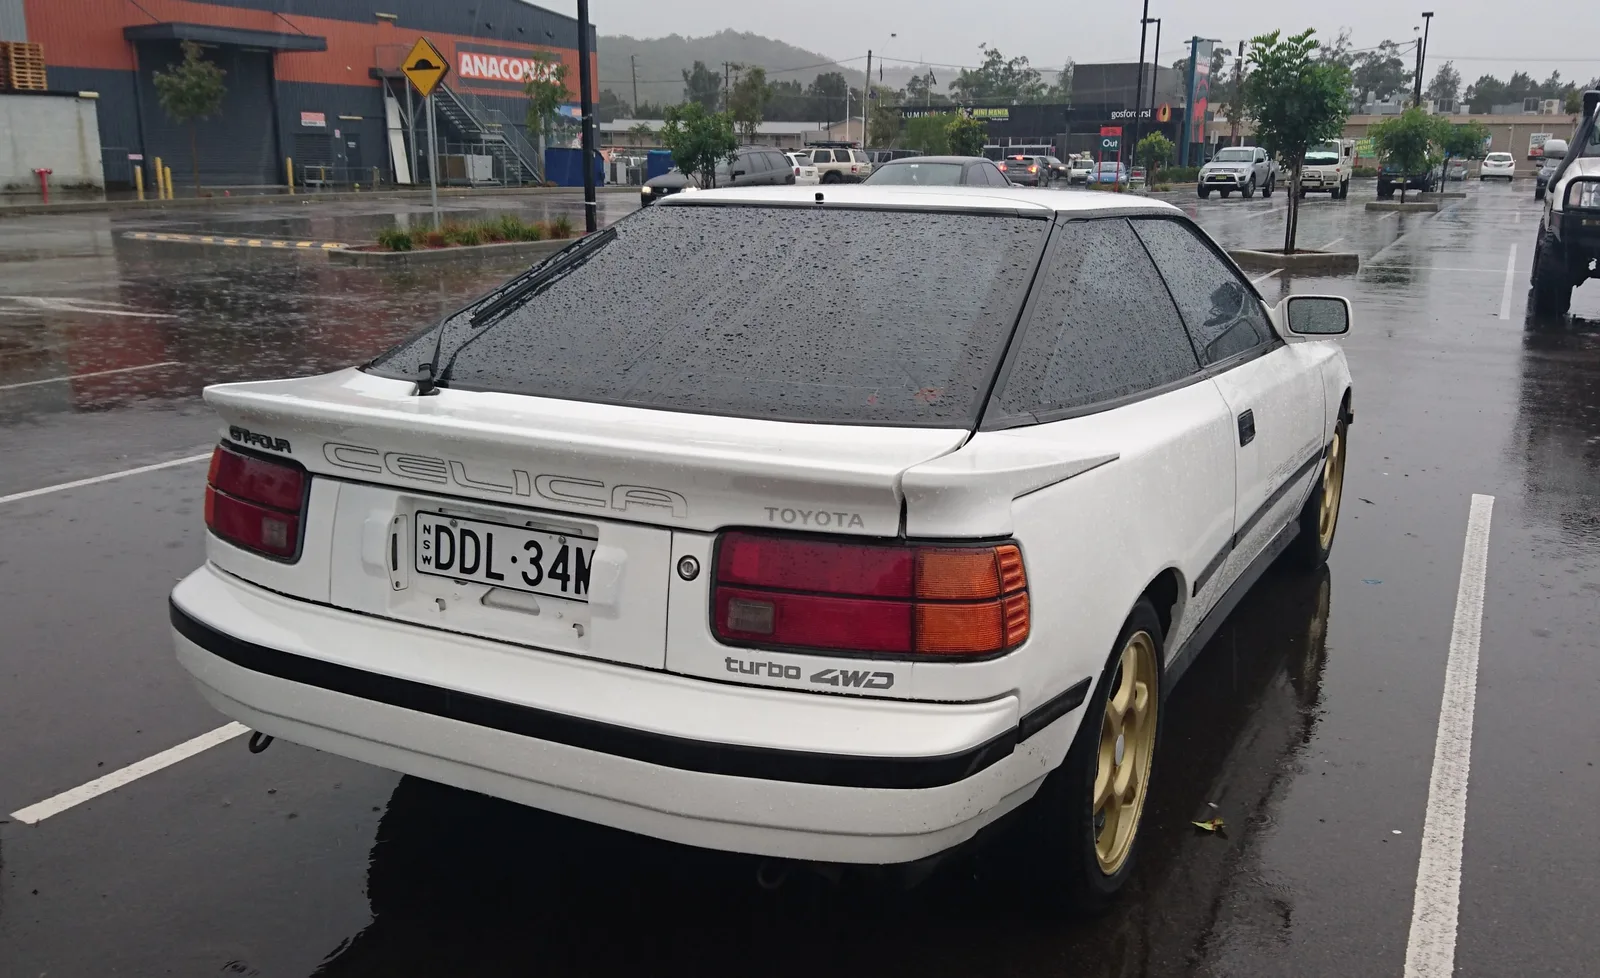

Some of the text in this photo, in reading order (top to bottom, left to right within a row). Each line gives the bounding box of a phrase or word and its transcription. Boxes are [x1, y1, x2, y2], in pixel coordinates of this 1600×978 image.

[902, 111, 947, 119] LUMINS
[1103, 139, 1118, 148] Out
[323, 442, 688, 519] CELICA
[764, 507, 865, 529] TOYOTA
[725, 656, 894, 690] turbo 4WD
